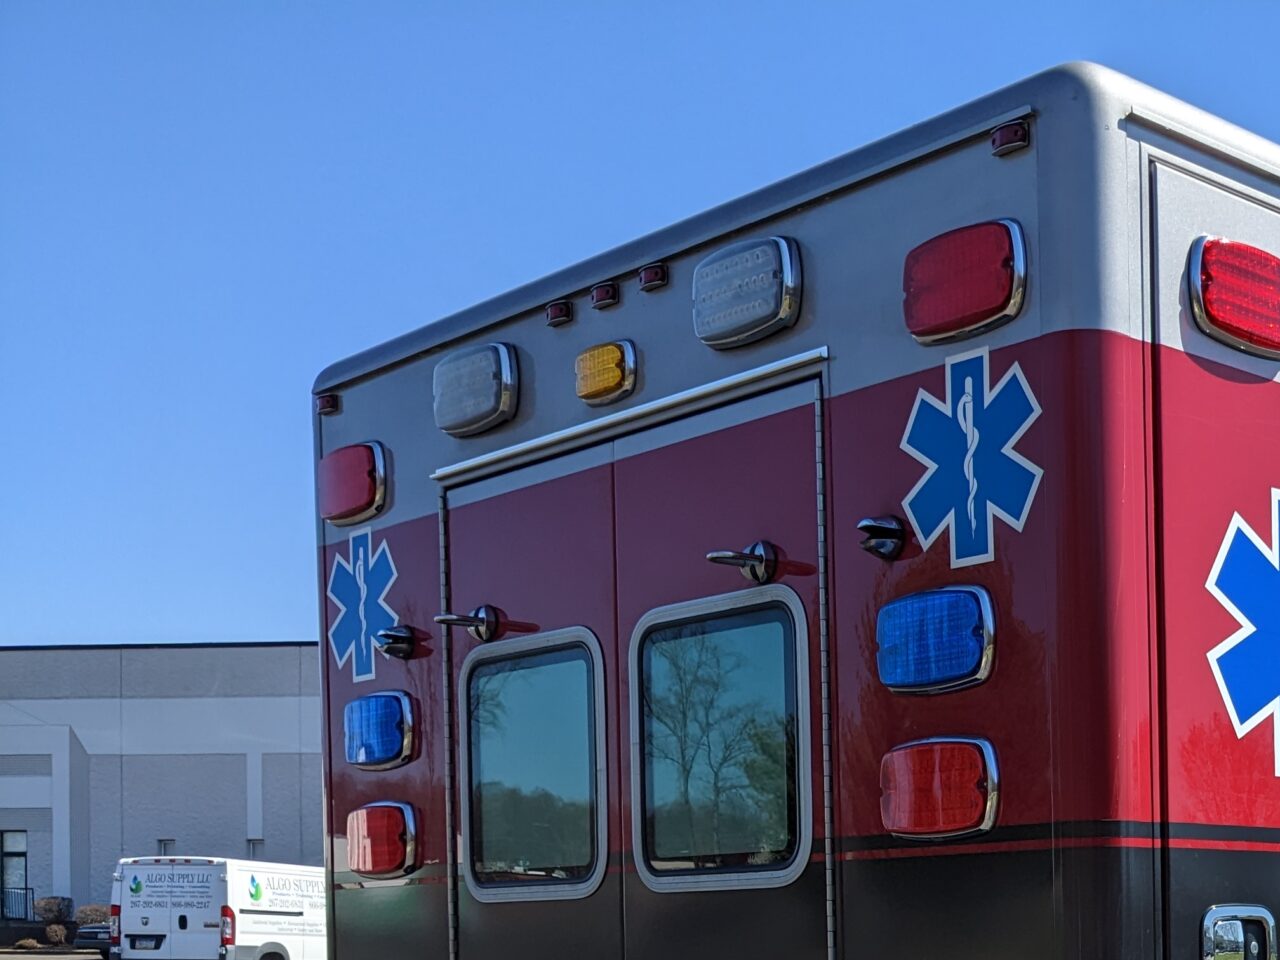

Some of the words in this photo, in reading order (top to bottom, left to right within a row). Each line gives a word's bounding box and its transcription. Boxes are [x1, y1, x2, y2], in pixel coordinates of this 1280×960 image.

[145, 872, 166, 884] ALGO
[167, 873, 196, 884] SUPPLY
[197, 873, 212, 884] LLC
[265, 876, 291, 891] ALGO
